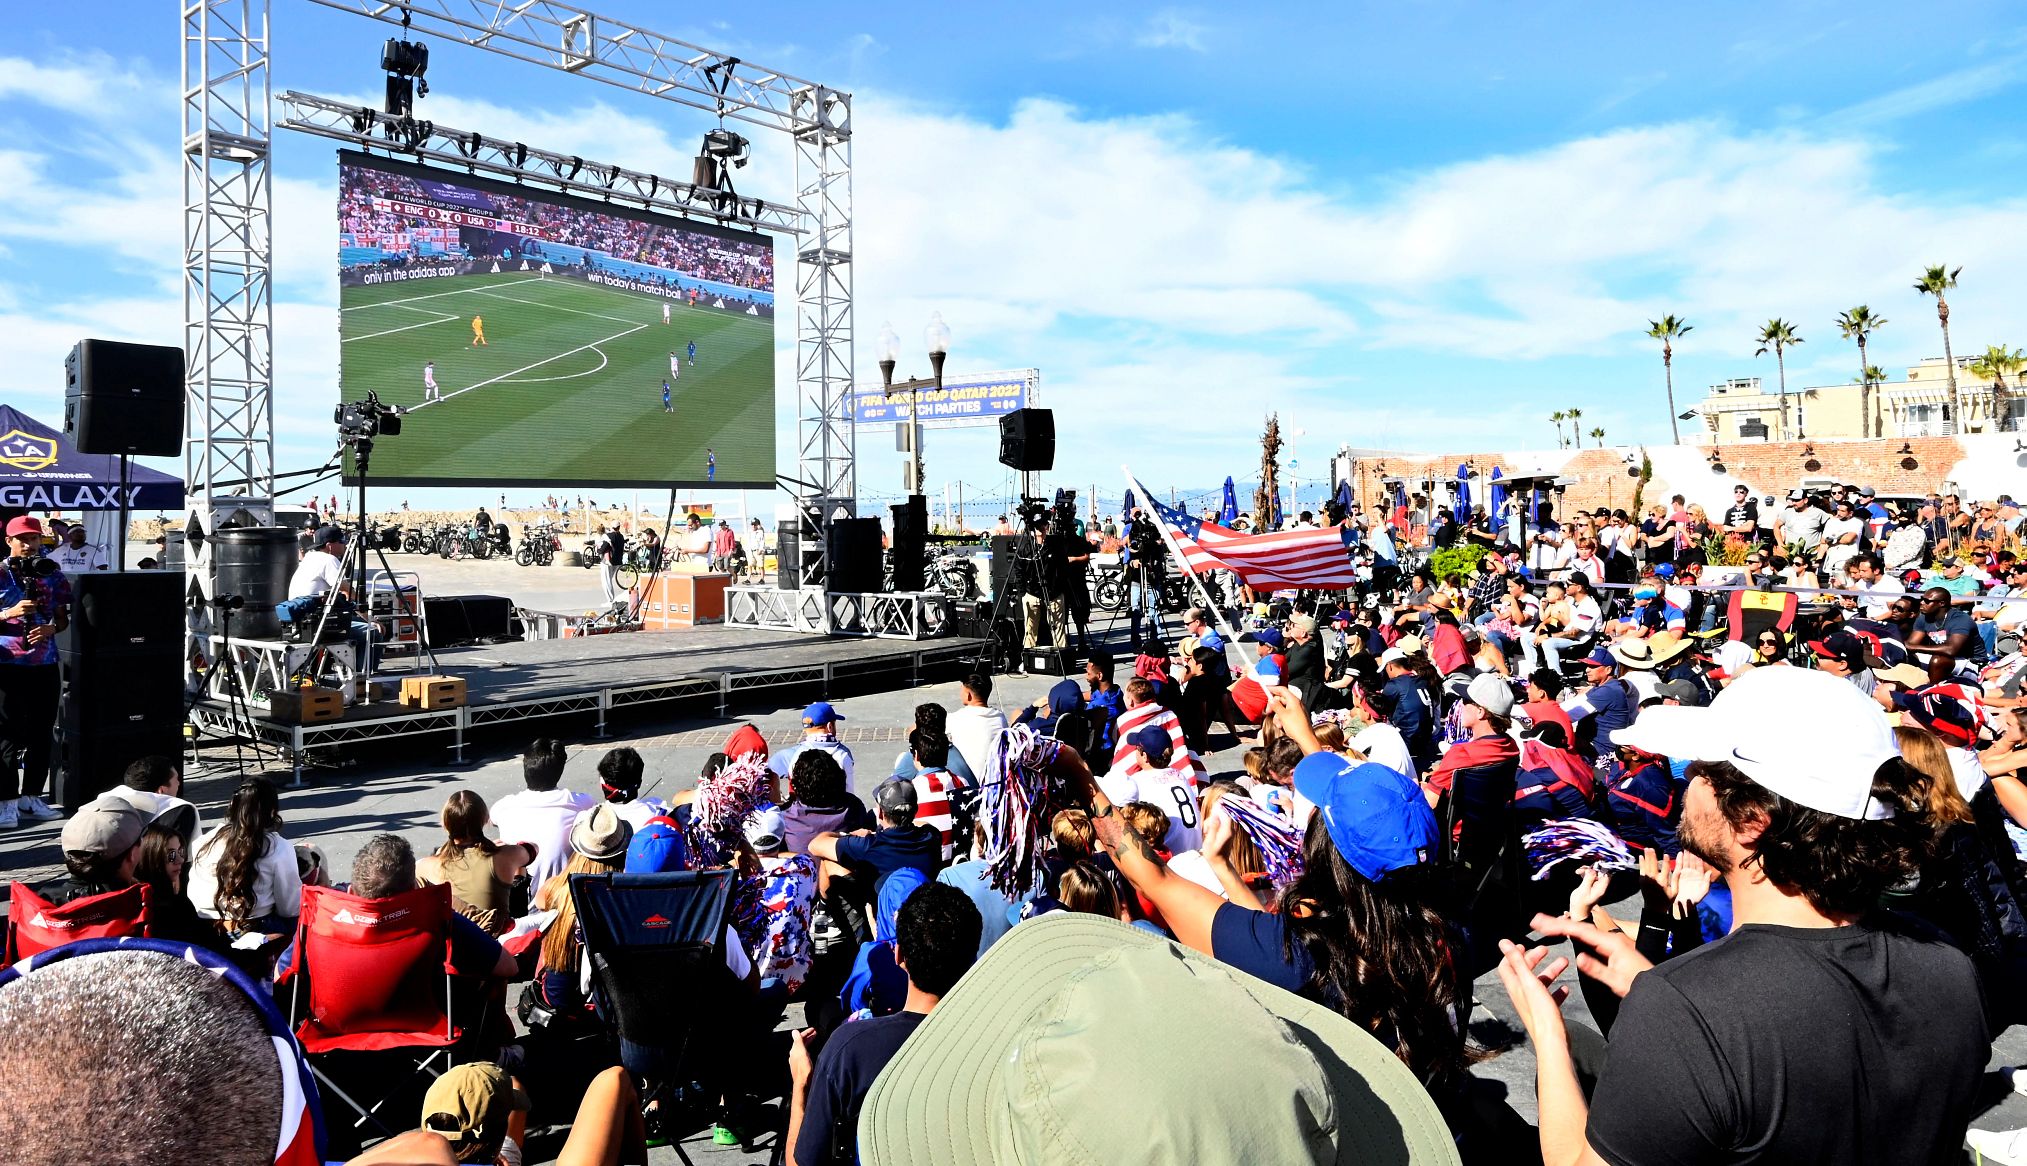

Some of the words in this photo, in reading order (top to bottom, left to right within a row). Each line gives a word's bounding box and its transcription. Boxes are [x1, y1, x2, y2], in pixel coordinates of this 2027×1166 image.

[394, 194, 409, 202] FIFA
[410, 196, 432, 206] WORLD
[468, 207, 488, 216] GROUP
[404, 204, 424, 216] ENG
[428, 209, 436, 219] 0
[454, 213, 462, 223] 0
[467, 215, 485, 227] USA
[515, 224, 540, 236] 18:12
[743, 254, 761, 266] FOX
[364, 270, 382, 285] only
[384, 270, 392, 282] in
[393, 268, 407, 281] the
[408, 266, 437, 279] adidas
[438, 266, 455, 276] app
[587, 272, 603, 284] win
[604, 274, 635, 290] today's
[637, 282, 665, 297] match
[861, 395, 883, 407] FIFA
[885, 391, 923, 404] WORD
[925, 390, 949, 402] CUP
[950, 386, 988, 401] QATAR
[989, 384, 1021, 397] 2022
[895, 404, 933, 416] WACH
[935, 401, 981, 414] PARTIES
[3, 445, 45, 457] LA
[0, 486, 142, 508] GALAXY
[1170, 785, 1197, 829] 8
